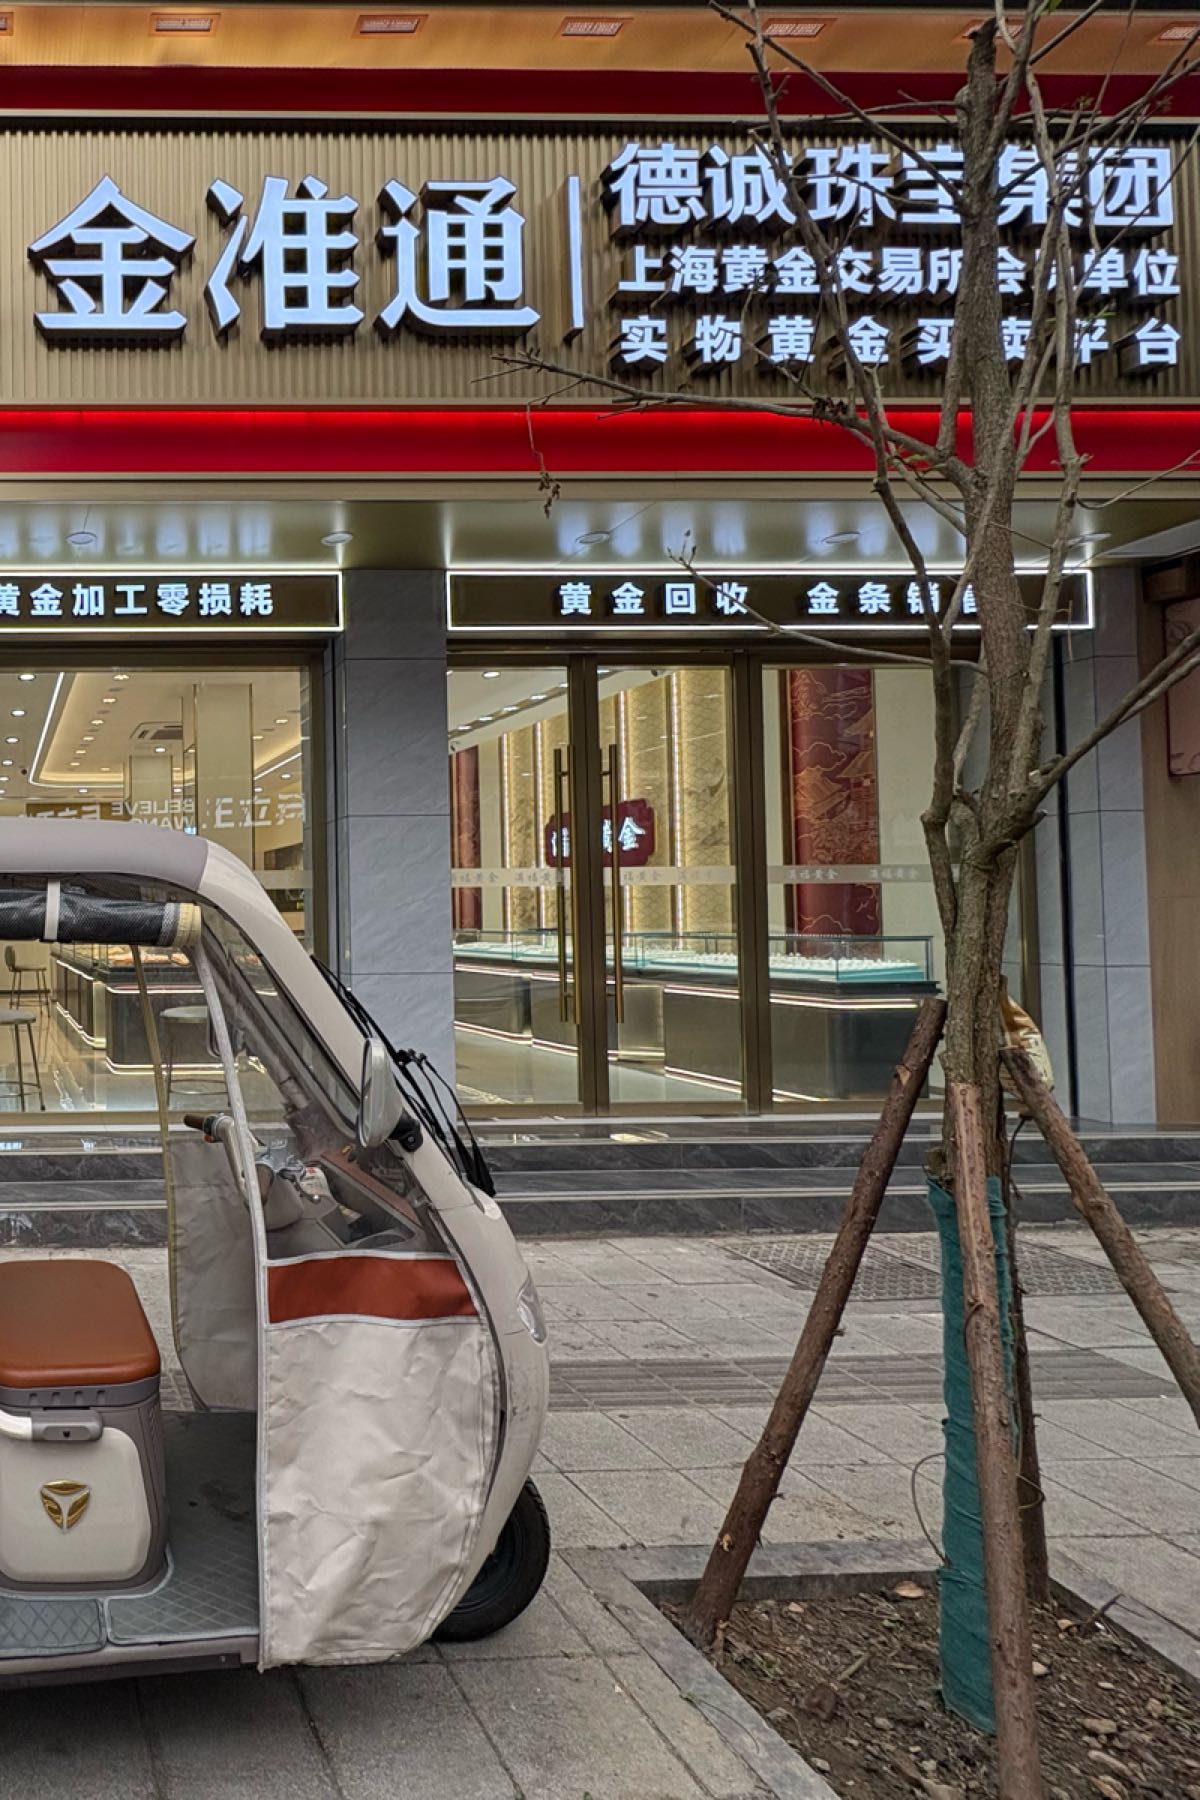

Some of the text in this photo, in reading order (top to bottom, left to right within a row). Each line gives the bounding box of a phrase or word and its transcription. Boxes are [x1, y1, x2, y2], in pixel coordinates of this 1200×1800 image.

[610, 143, 1174, 227] 德诚珠宝集团
[29, 175, 540, 330] 金准通
[558, 583, 750, 616] 黄金回收
